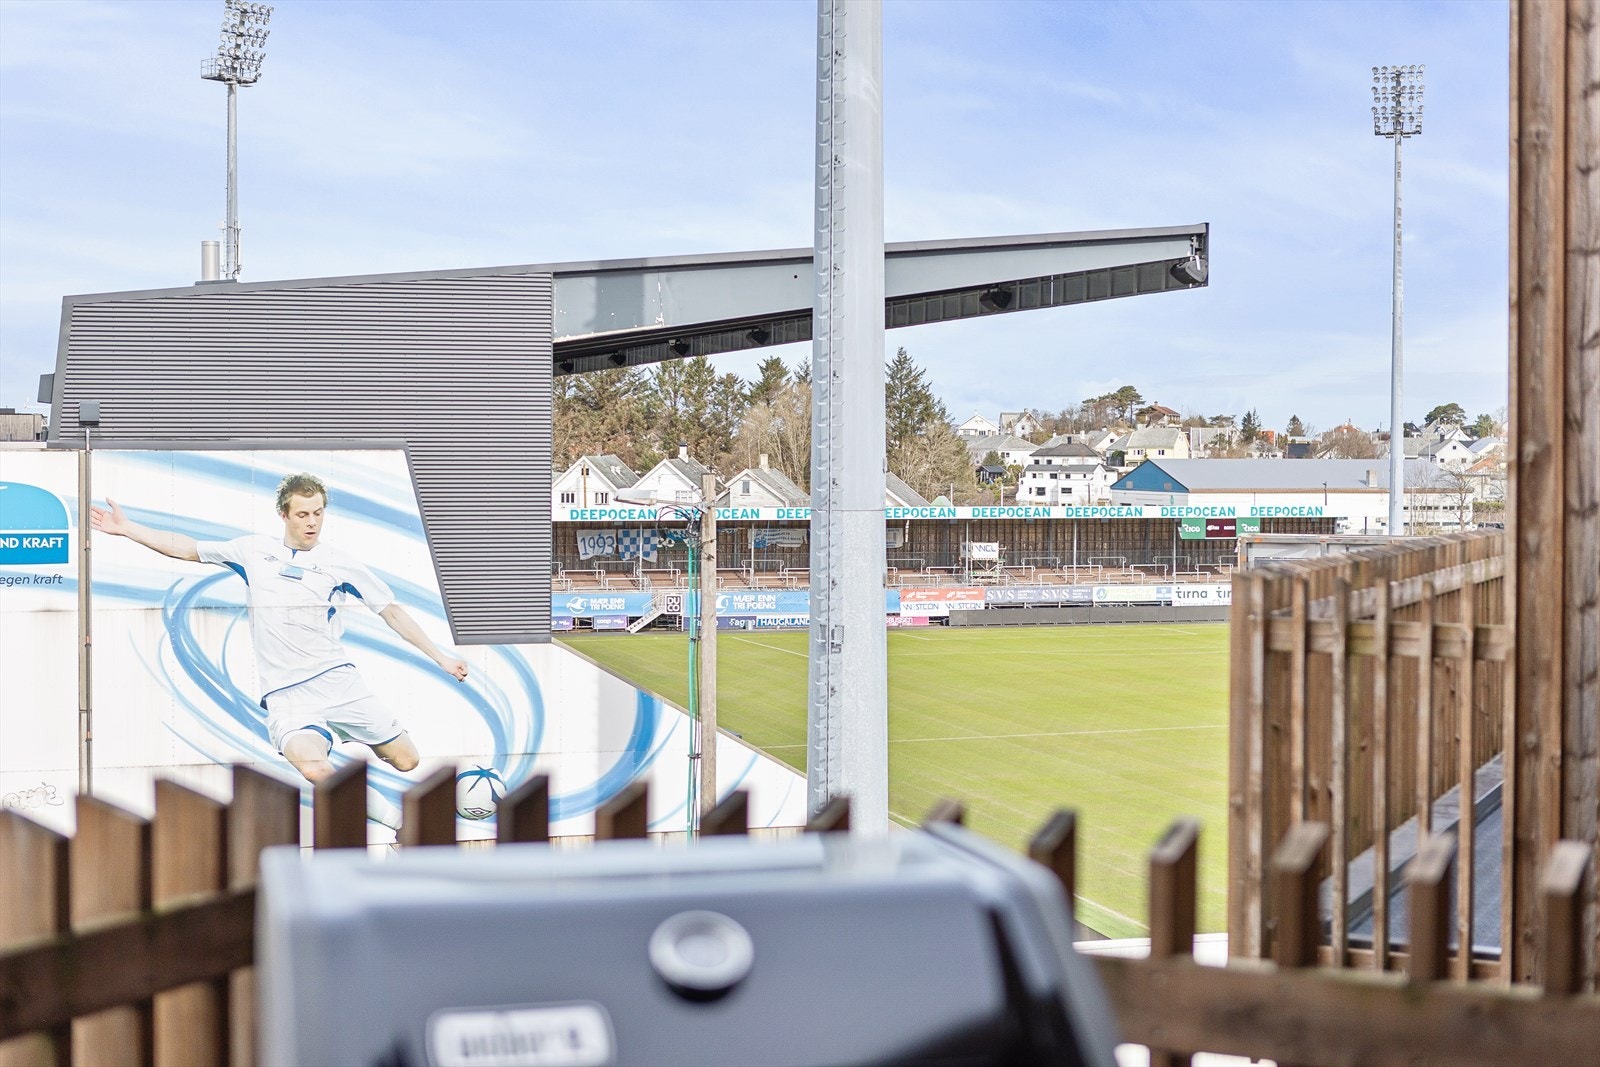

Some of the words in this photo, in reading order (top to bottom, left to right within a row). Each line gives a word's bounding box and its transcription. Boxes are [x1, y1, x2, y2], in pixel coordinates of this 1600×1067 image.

[570, 509, 657, 520] DEEPOCEAN
[885, 507, 956, 518] EEPOCEAN
[972, 507, 1051, 518] DEEPOCEAN
[1066, 507, 1143, 518] DEEPOCEAN
[1161, 506, 1236, 517] DEEPOCEAN
[1251, 506, 1323, 517] DEEPOCEAN
[22, 537, 64, 549] KRAFT
[580, 535, 615, 556] 1993
[33, 573, 63, 585] kraft
[757, 594, 776, 602] ENN
[733, 602, 746, 610] TRI
[746, 602, 776, 610] POENG
